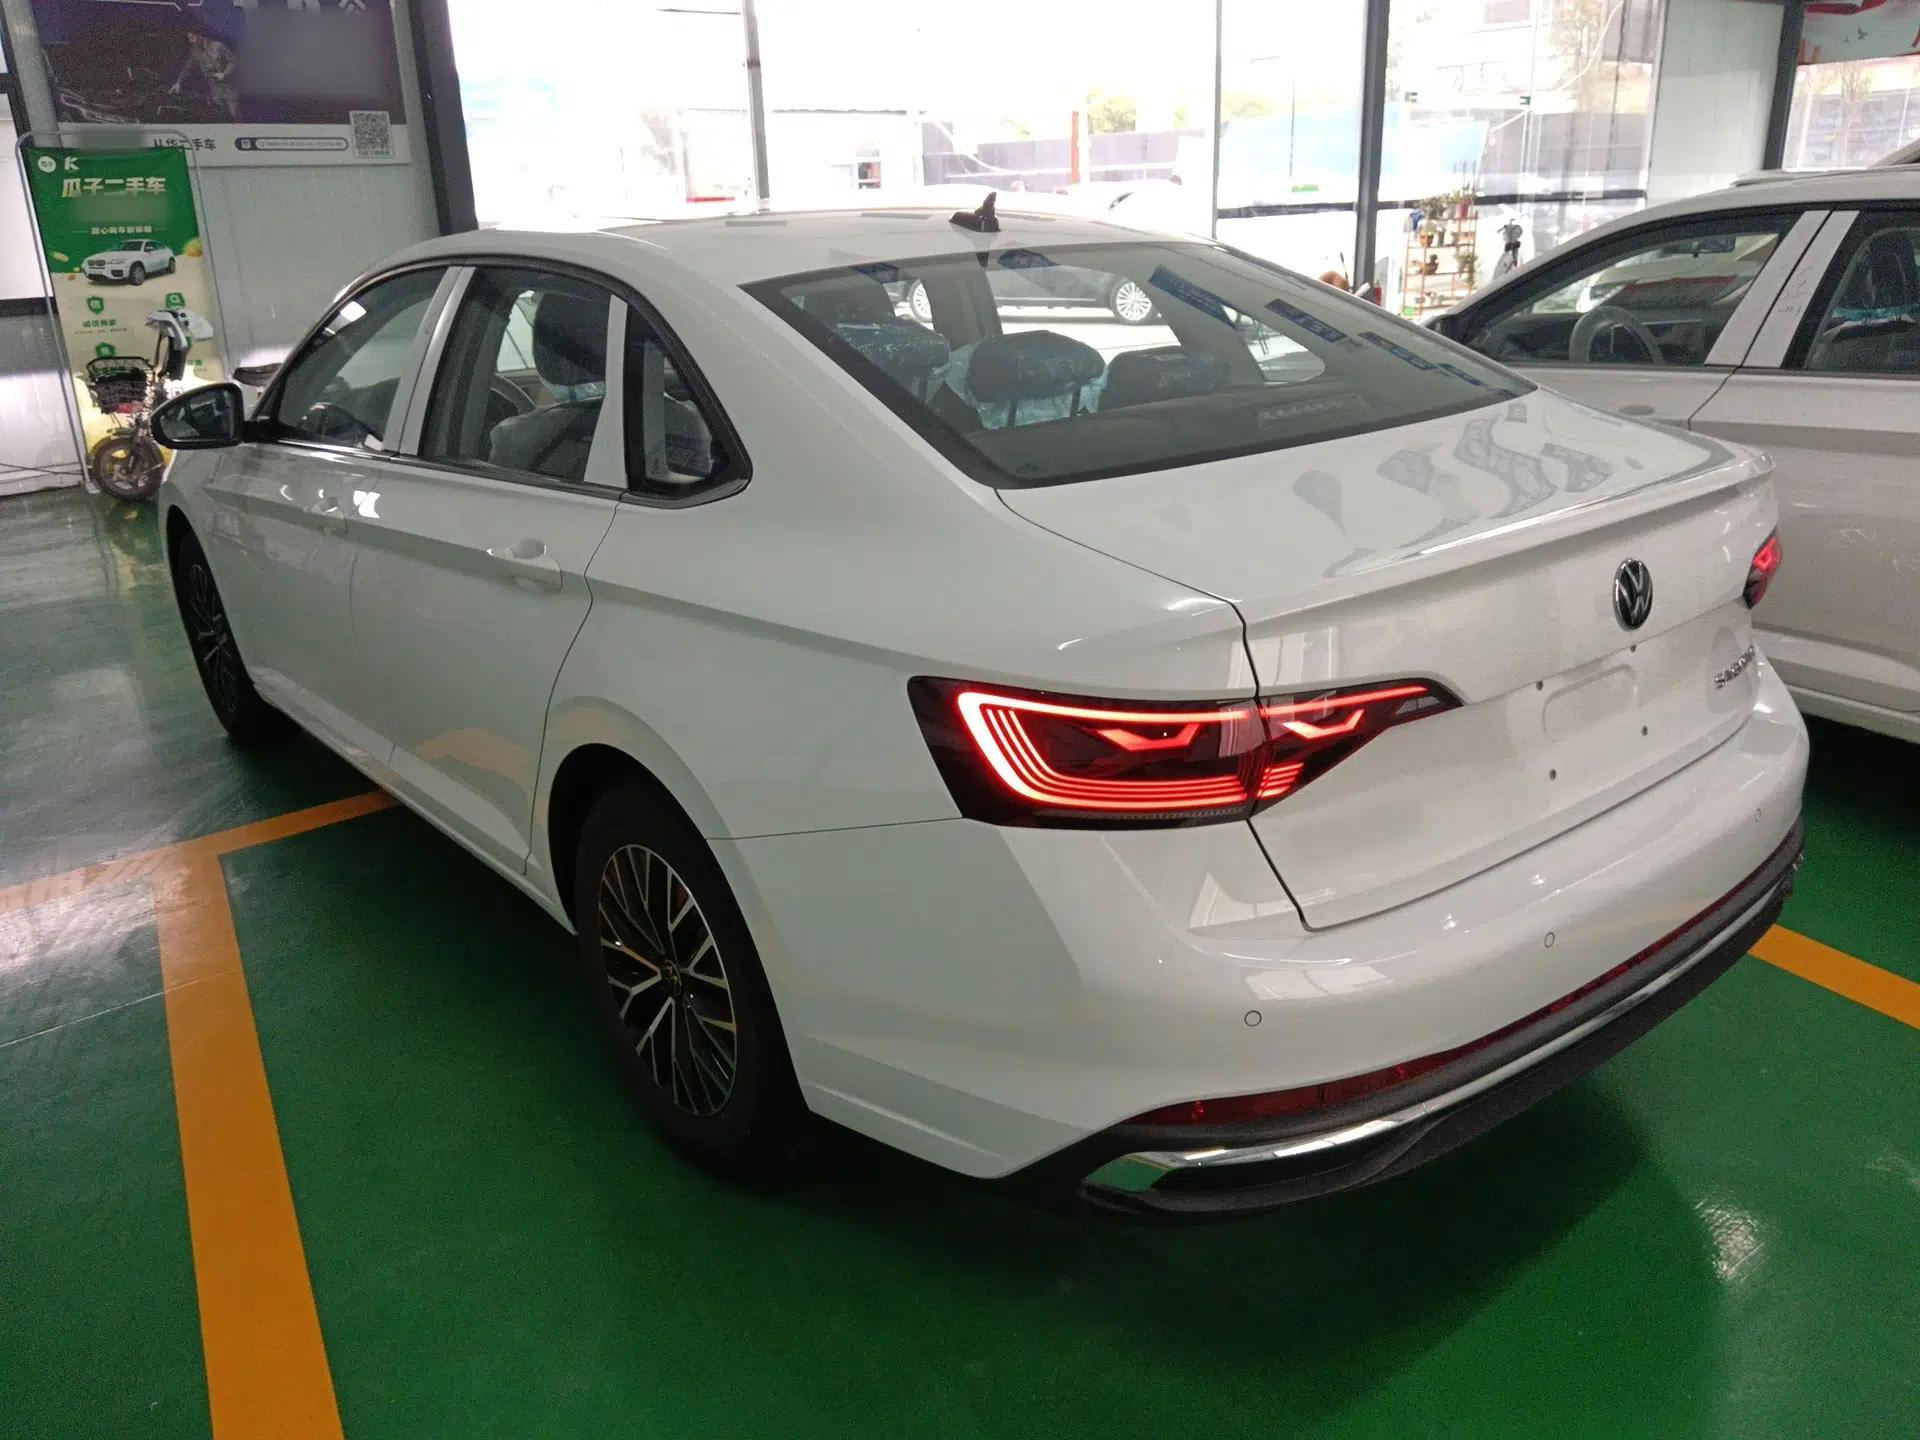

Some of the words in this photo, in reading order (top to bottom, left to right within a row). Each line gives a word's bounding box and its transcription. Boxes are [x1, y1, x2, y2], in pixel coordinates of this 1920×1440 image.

[62, 176, 166, 198] 瓜子二手车
